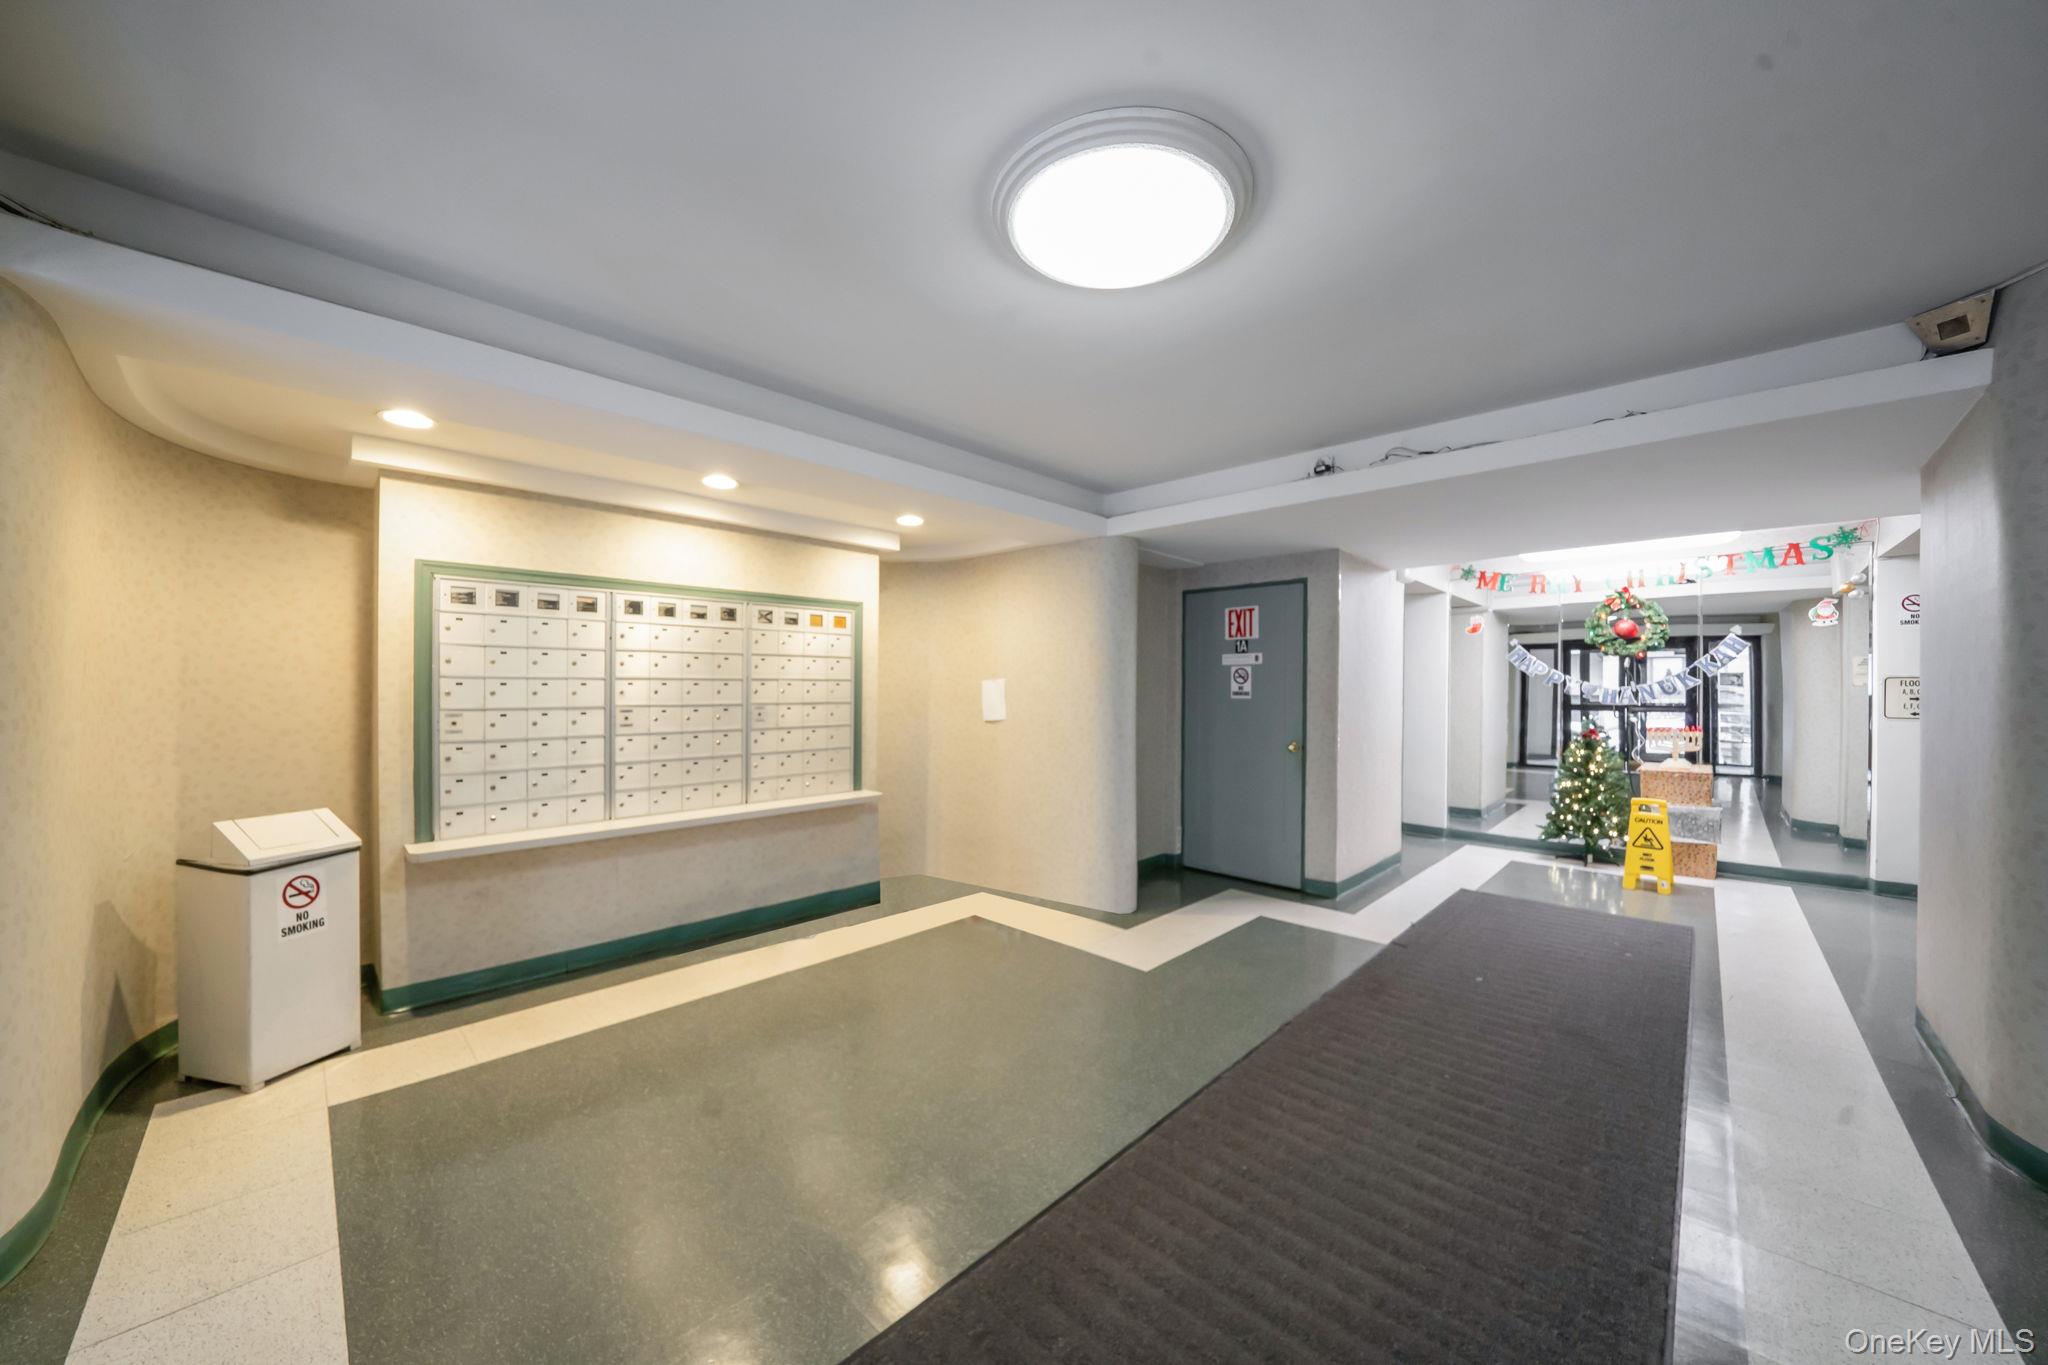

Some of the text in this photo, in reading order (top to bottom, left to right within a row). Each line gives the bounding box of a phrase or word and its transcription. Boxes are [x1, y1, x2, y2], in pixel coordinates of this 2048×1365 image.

[1604, 535, 1834, 588] HRISTMAS
[1228, 607, 1255, 638] EXIT
[1236, 640, 1247, 652] 1A
[296, 910, 309, 922] NO
[281, 917, 325, 937] SMOKING
